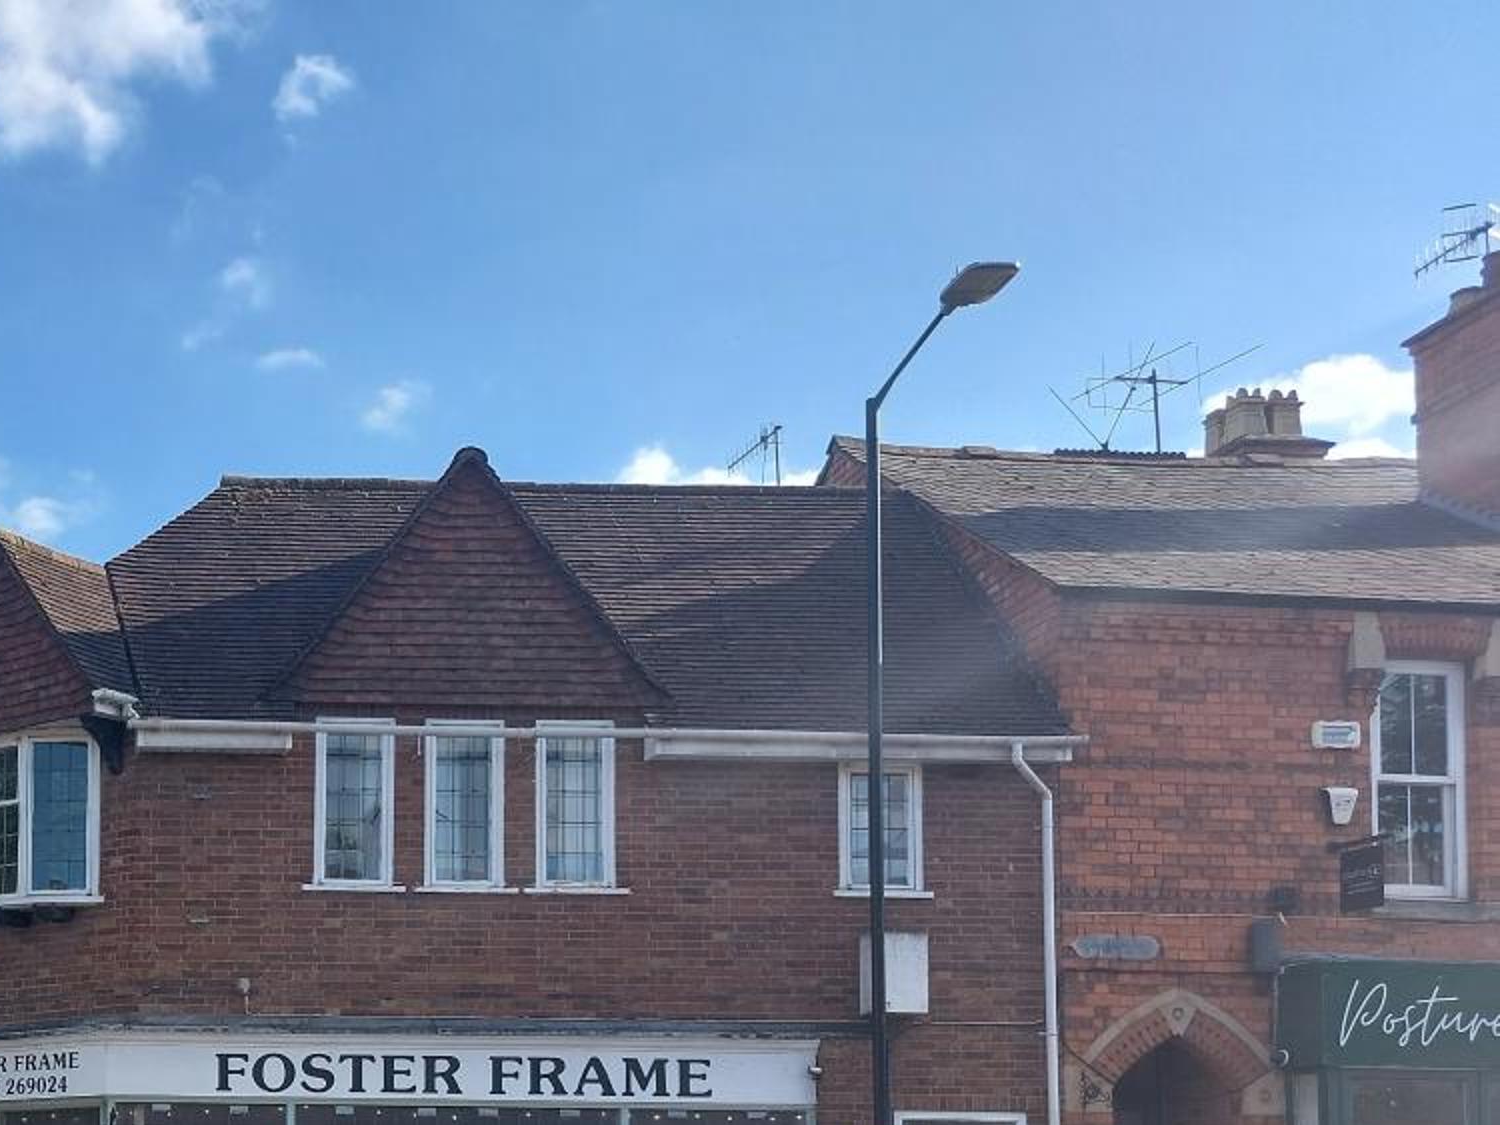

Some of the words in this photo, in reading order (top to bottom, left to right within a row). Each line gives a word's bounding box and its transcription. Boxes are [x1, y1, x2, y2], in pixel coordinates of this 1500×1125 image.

[15, 1051, 80, 1072] FRAME
[6, 1075, 68, 1095] 269024
[215, 1053, 463, 1095] FOSTER
[489, 1055, 714, 1098] FRAME
